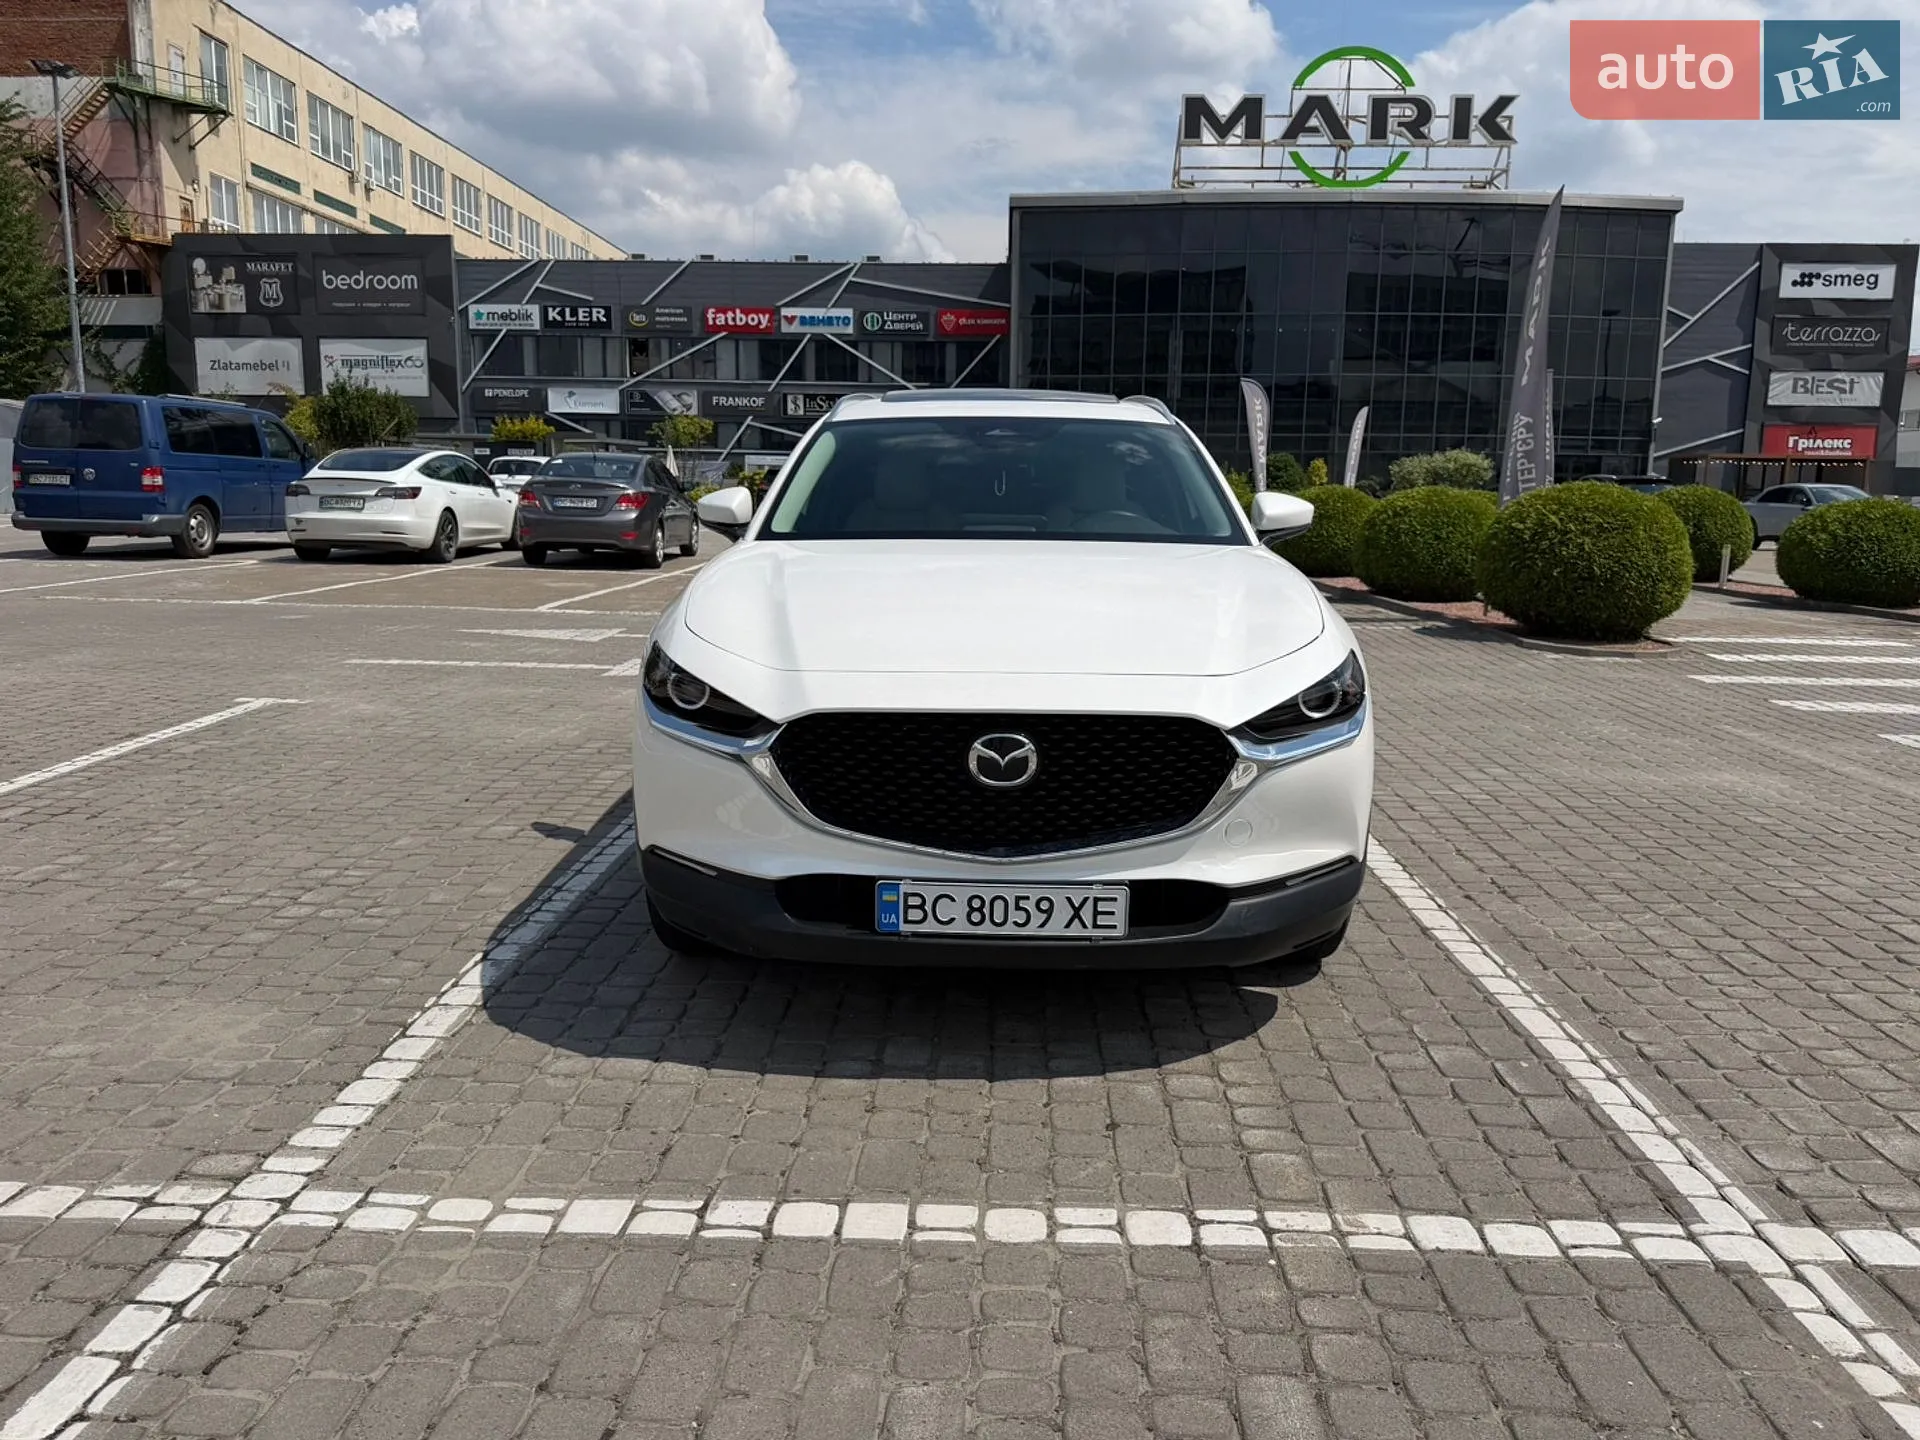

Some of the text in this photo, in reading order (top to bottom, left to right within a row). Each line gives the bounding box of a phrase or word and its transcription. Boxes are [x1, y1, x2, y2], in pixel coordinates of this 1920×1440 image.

[1181, 94, 1520, 145] MARK
[246, 262, 293, 272] MARAFET
[322, 269, 418, 289] bedroom
[1822, 273, 1879, 290] smeg
[487, 309, 533, 322] meblik
[547, 306, 607, 322] KLER
[1783, 323, 1881, 341] terrazza
[209, 360, 279, 371] Zlatamebel
[712, 397, 766, 407] FRANKOF
[1788, 436, 1852, 451] Грілекс
[881, 913, 897, 923] UA
[903, 892, 1118, 929] BC 8059 XE
